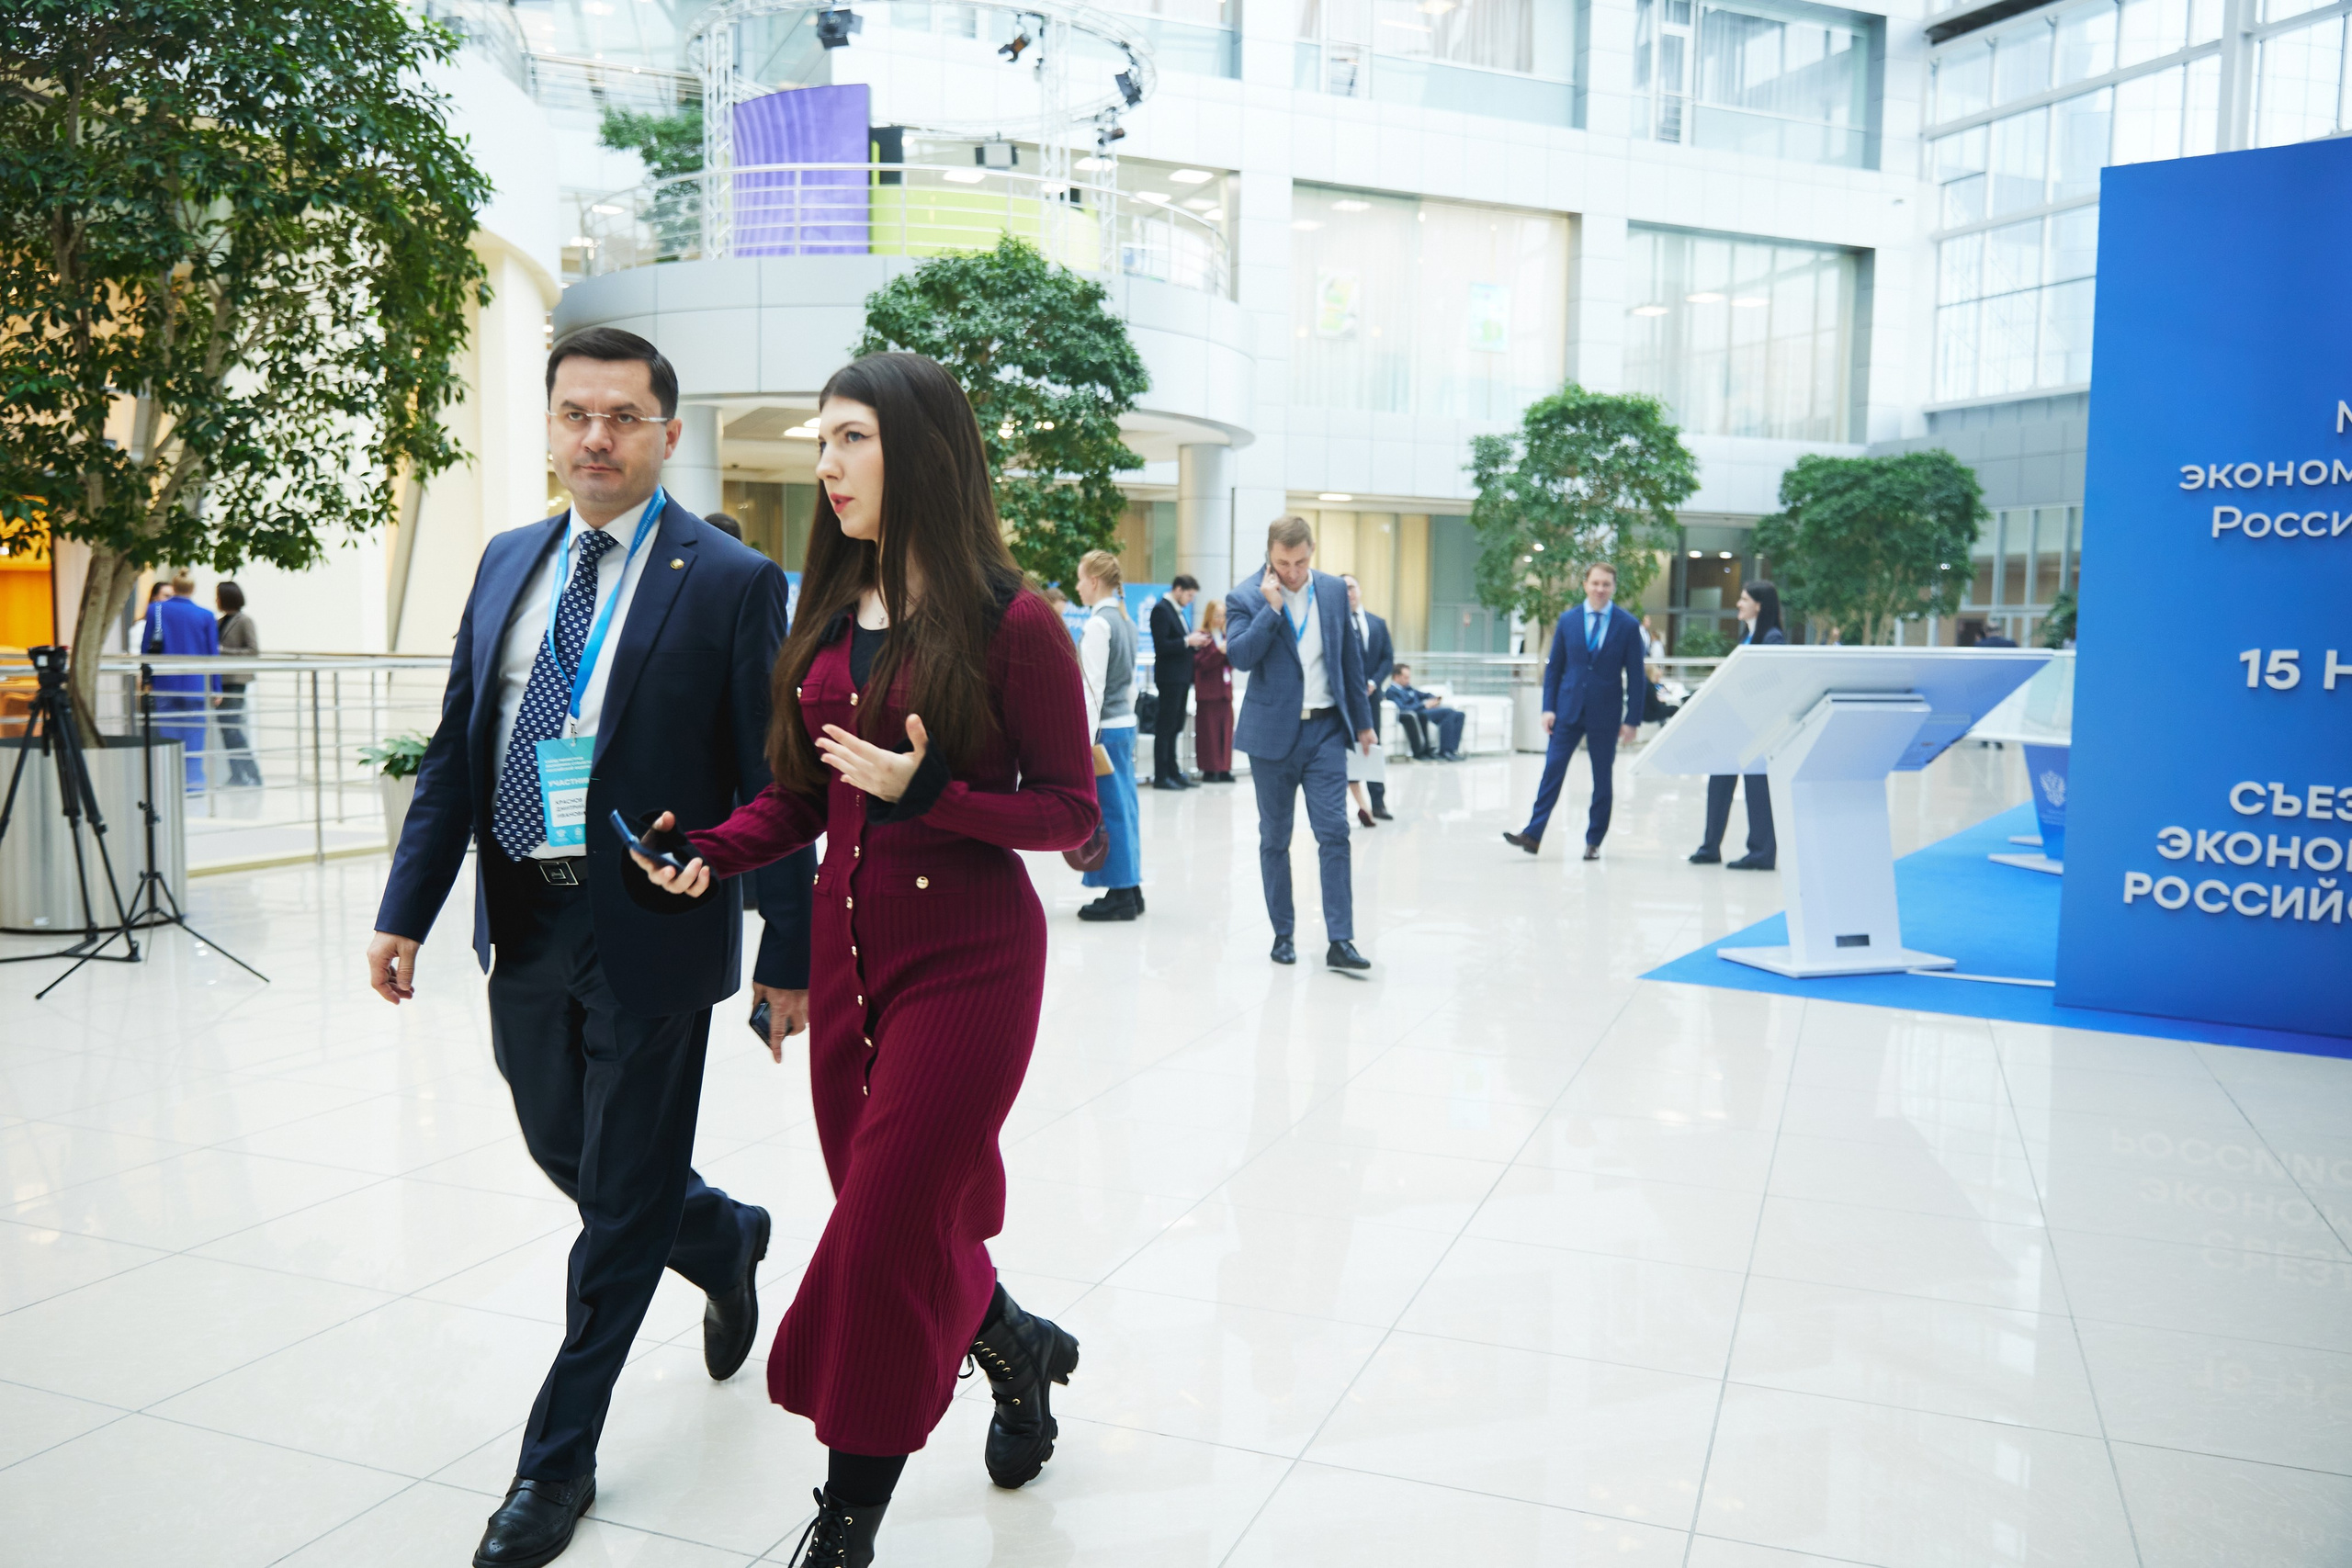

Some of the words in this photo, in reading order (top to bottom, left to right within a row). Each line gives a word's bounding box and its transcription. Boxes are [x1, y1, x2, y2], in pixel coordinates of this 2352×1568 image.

[2239, 648, 2301, 690] 15
[2156, 826, 2352, 873] ЭКОНО
[2123, 871, 2352, 924] РОССИЙ
